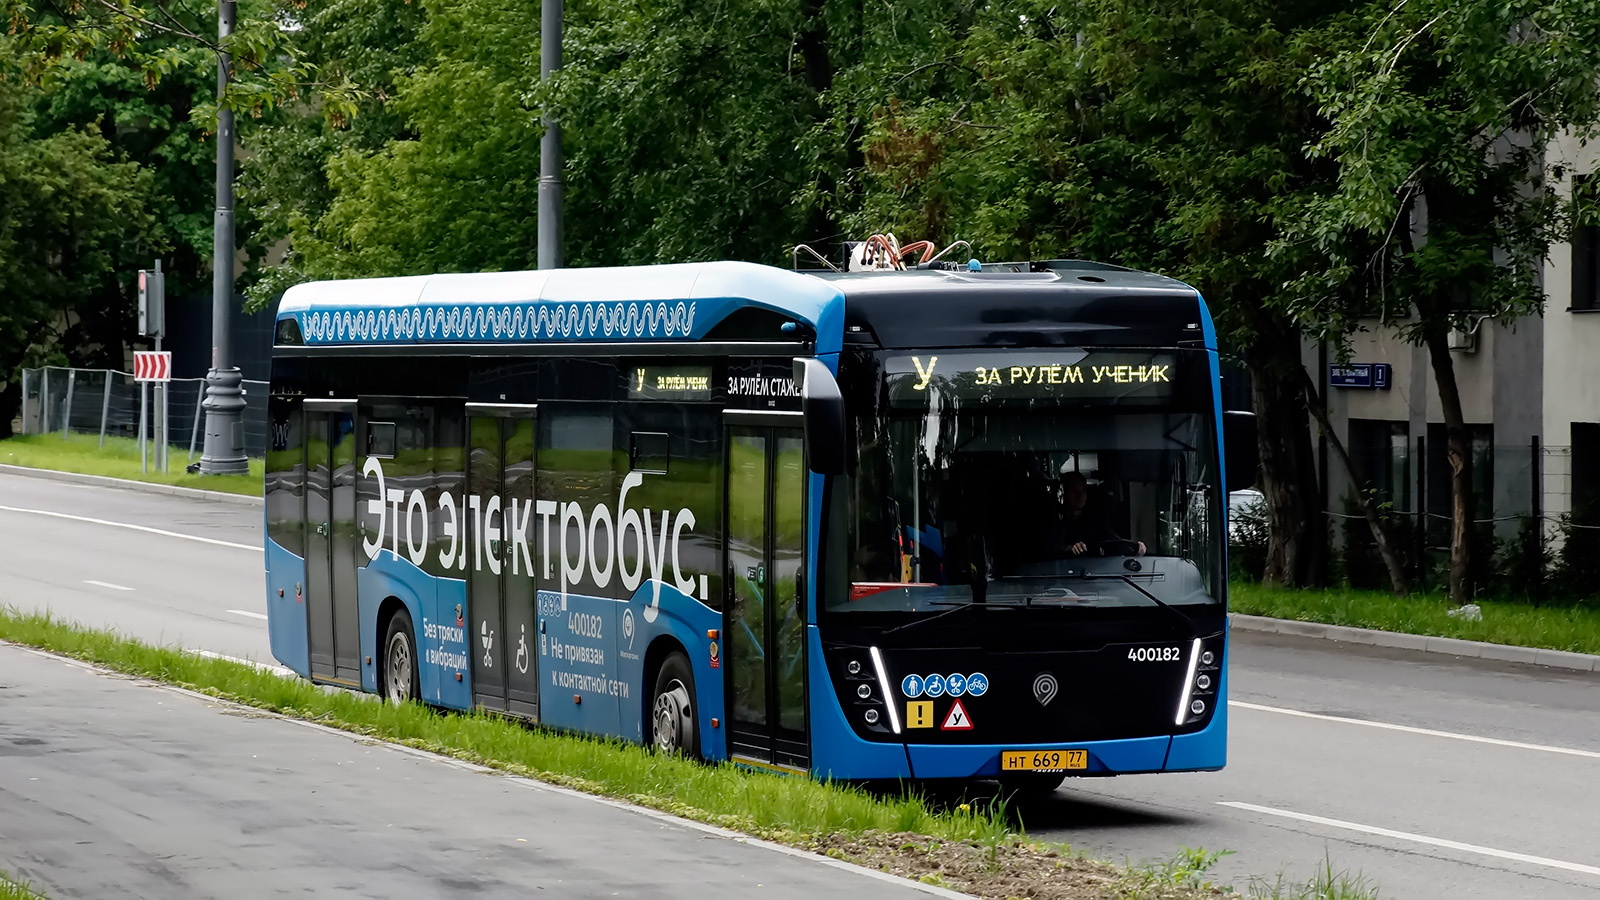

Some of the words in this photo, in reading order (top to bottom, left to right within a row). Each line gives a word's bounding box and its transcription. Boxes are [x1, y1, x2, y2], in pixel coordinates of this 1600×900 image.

[636, 368, 646, 392] У
[656, 375, 666, 390] ЗА
[666, 374, 686, 390] РУЛЁМ
[727, 377, 739, 395] ЗА
[739, 373, 770, 396] РУЛЁМ
[911, 356, 938, 391] У
[974, 366, 1002, 385] ЗА
[1010, 363, 1084, 385] РУЛЁМ
[1092, 365, 1170, 384] УЧЕНИК
[363, 457, 428, 567] Это
[438, 471, 709, 624] электробус.
[423, 617, 437, 639] Без
[437, 624, 464, 645] тряски
[568, 611, 602, 639] 400182
[430, 645, 467, 672] вибраций
[550, 637, 563, 659] Не
[565, 644, 604, 666] привязан
[1127, 647, 1180, 662] 400182
[552, 670, 558, 686] к
[558, 673, 607, 694] контактной
[608, 679, 629, 699] сети
[1009, 756, 1026, 768] НТ
[1032, 753, 1060, 768] 669
[1068, 751, 1083, 763] 77
